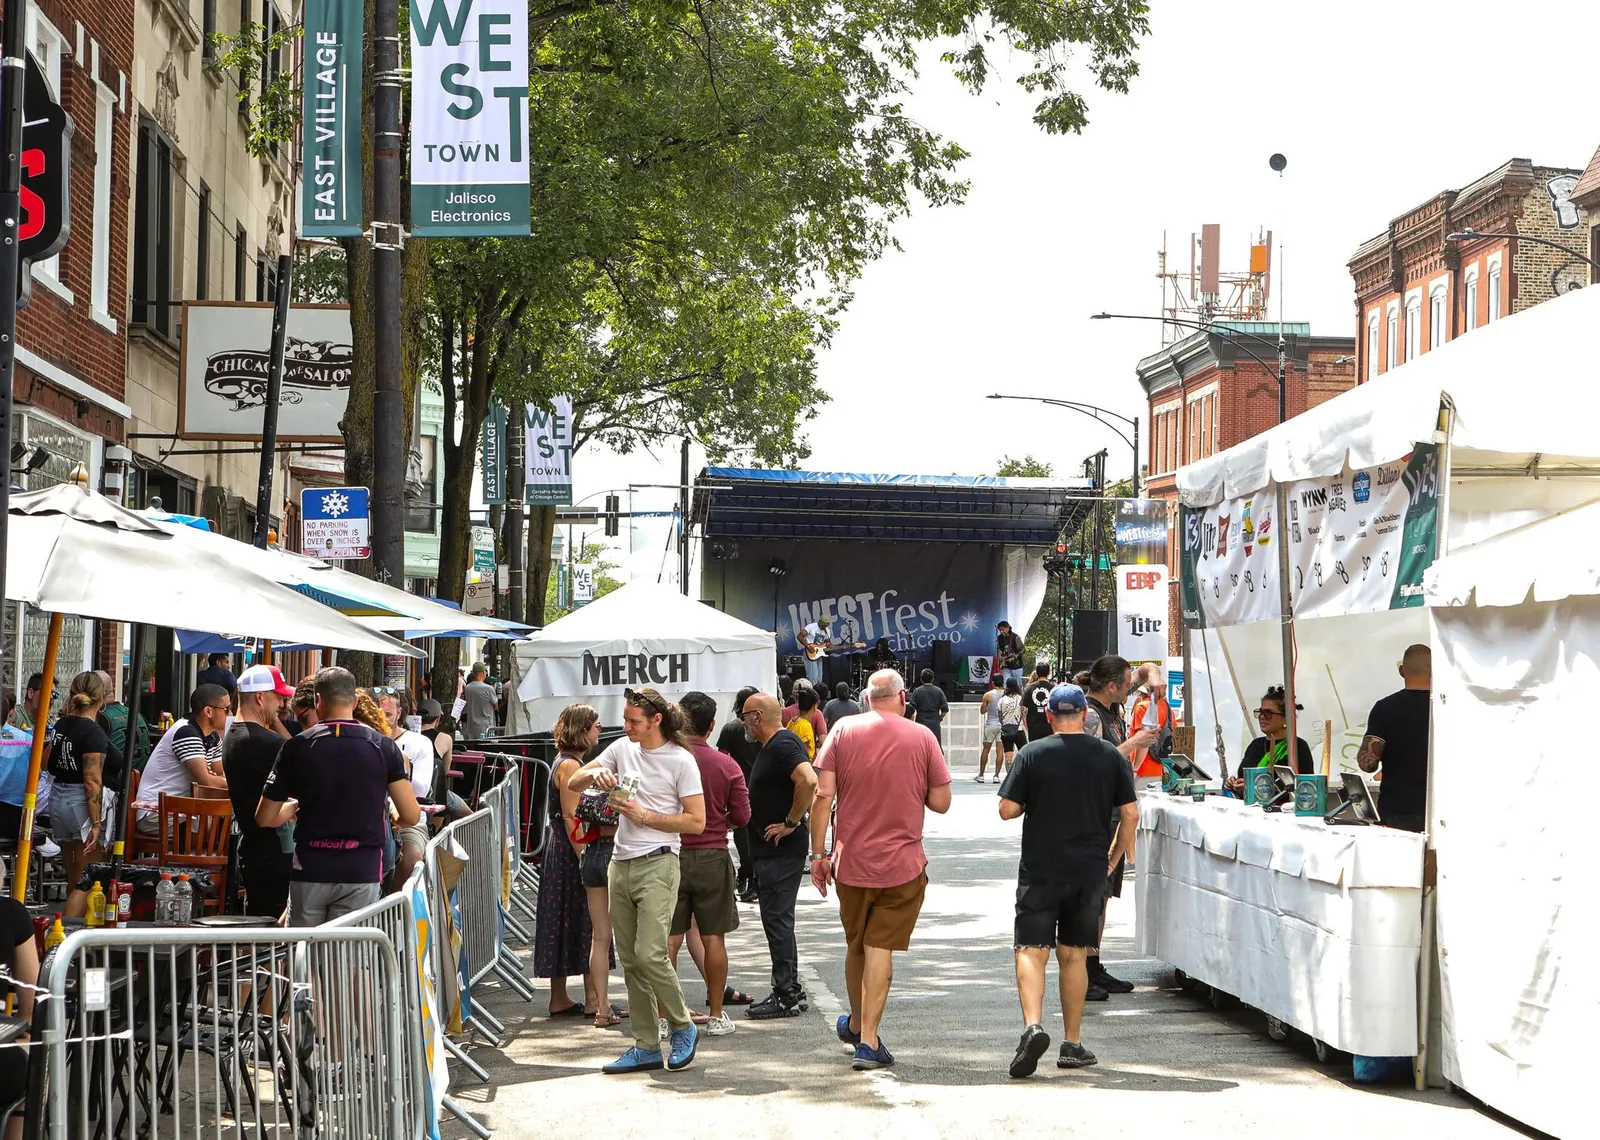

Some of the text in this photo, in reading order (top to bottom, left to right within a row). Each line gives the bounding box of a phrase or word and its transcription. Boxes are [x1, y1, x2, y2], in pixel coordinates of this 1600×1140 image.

[314, 31, 337, 221] EAST VILLAGE
[423, 144, 500, 163] TOWN
[445, 192, 497, 205] Jalisco
[430, 210, 511, 222] Electronics
[287, 364, 304, 378] AVE
[487, 422, 496, 499] EAST VILLAGE
[530, 467, 561, 476] TOWN
[1300, 487, 1328, 508] WYNK
[1331, 482, 1343, 496] TRES
[336, 547, 364, 557] ZONE
[1126, 571, 1162, 590] EBP
[1130, 616, 1162, 636] Lite
[887, 629, 962, 653] chicago
[582, 653, 690, 686] MERCH
[309, 839, 346, 849] unicef
